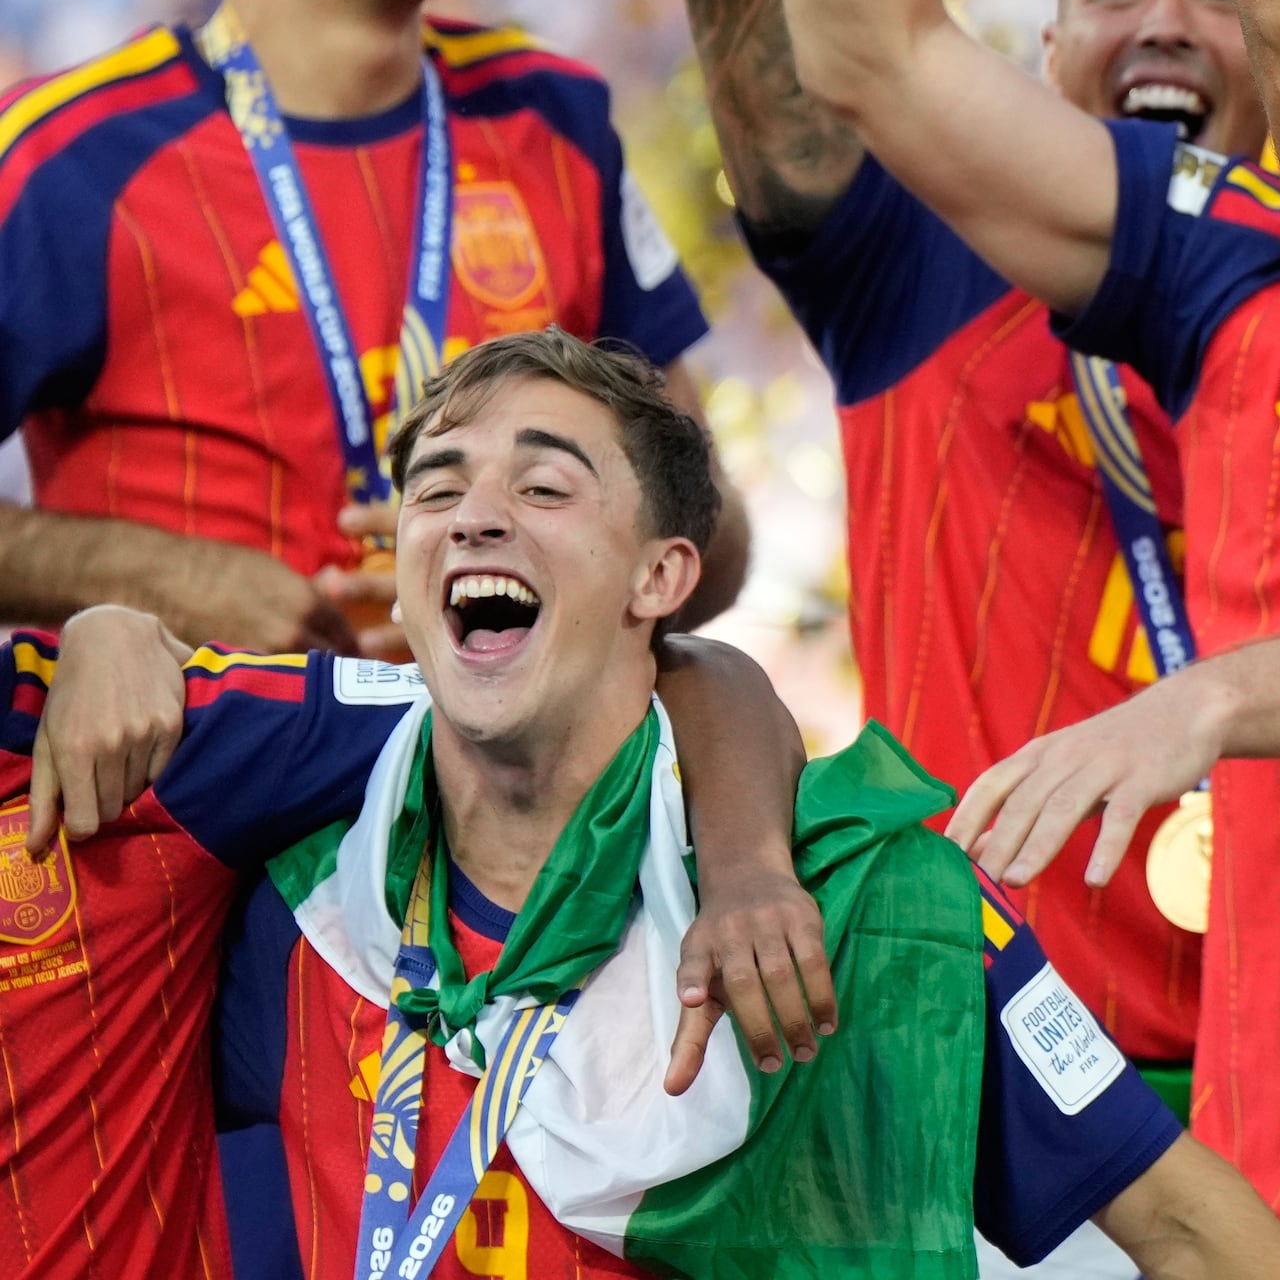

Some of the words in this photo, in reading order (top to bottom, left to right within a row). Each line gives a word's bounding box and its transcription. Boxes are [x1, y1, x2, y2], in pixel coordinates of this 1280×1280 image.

[35, 970, 56, 985] NEW
[57, 960, 89, 979] JERSEY
[1022, 984, 1068, 1033] FOOTBALL
[1033, 1001, 1083, 1053] UNITES
[1050, 1050, 1075, 1076] the
[1079, 1054, 1100, 1074] FIFA
[399, 1193, 456, 1280] 2026
